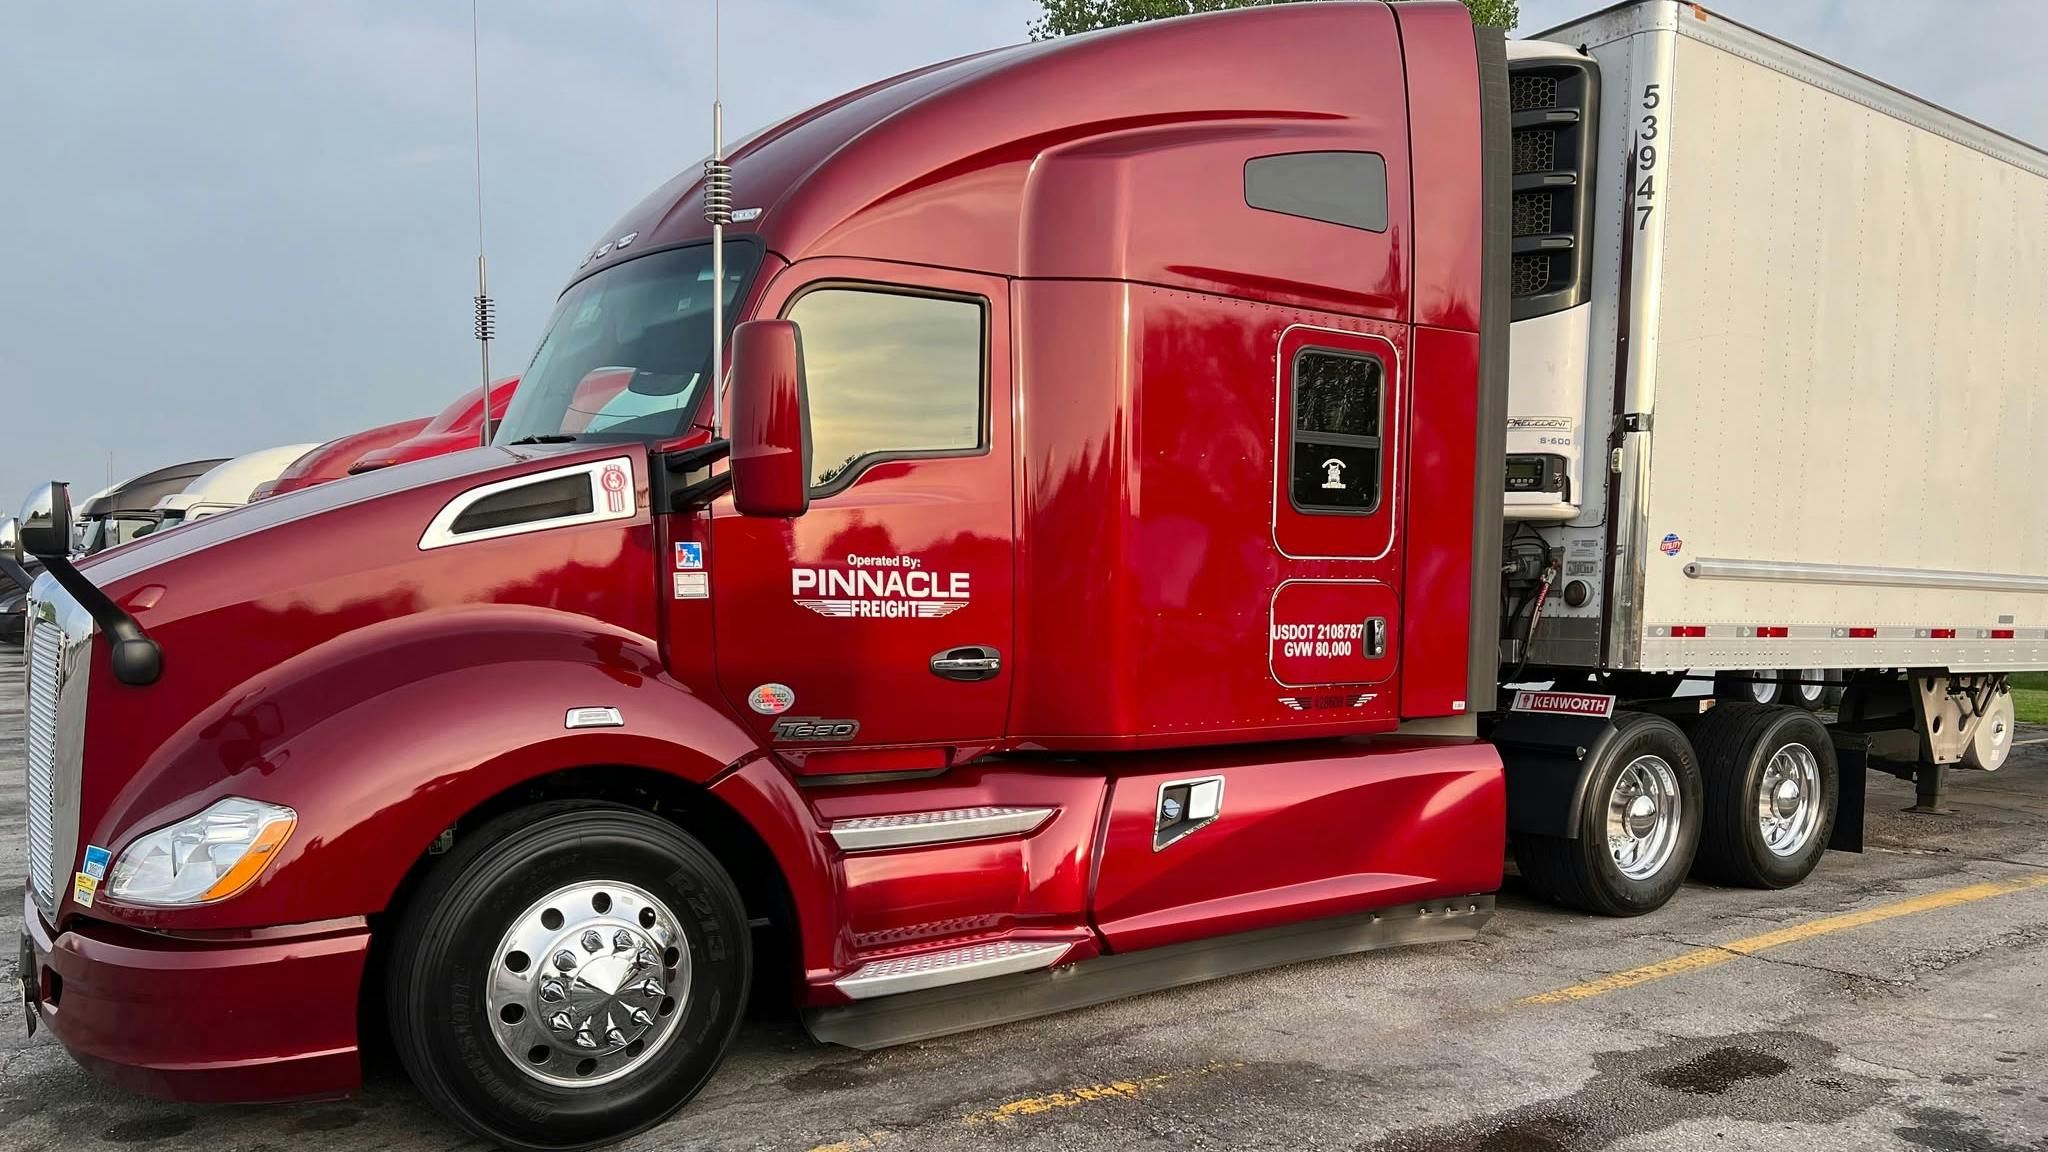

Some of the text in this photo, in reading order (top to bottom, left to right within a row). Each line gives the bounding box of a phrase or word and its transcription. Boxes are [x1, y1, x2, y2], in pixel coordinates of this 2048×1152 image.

[1636, 84, 1660, 230] 53947
[847, 553, 921, 569] Operated By:
[791, 568, 970, 598] PINNACLE
[851, 601, 919, 618] FREIGHT
[1273, 624, 1363, 640] USDOT 2108787
[1284, 641, 1352, 659] GVW 80,000
[1533, 696, 1607, 712] KENWORTH
[779, 722, 853, 737] T680
